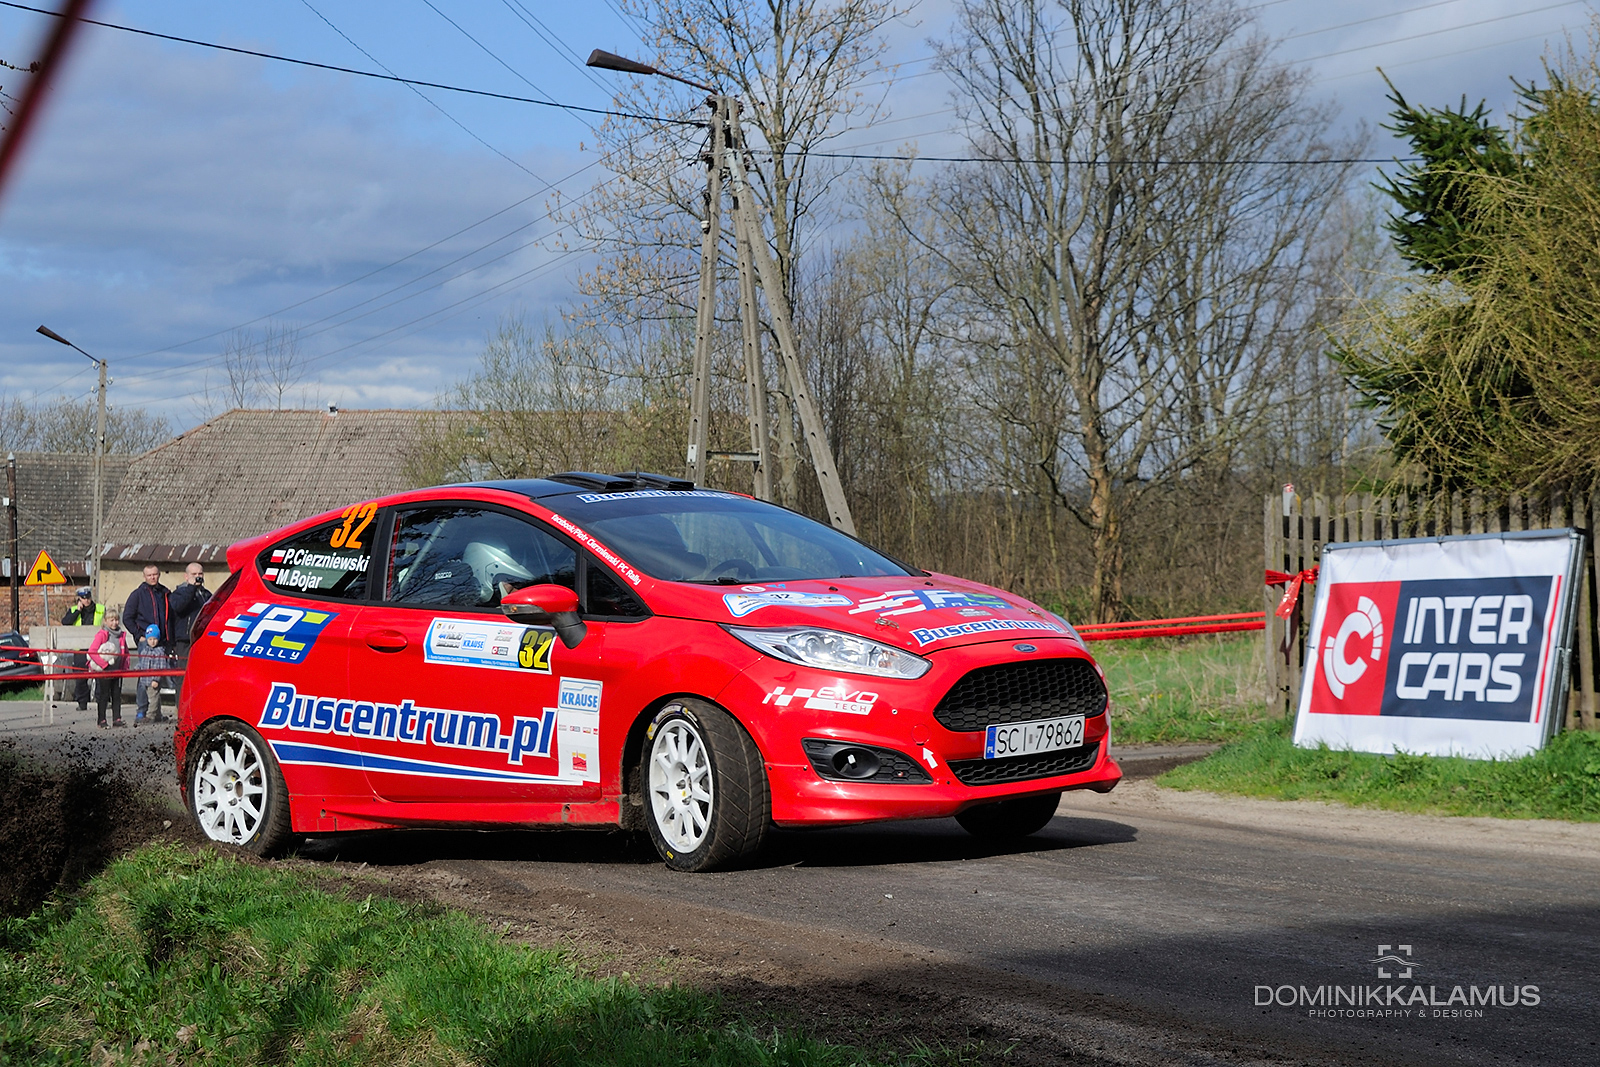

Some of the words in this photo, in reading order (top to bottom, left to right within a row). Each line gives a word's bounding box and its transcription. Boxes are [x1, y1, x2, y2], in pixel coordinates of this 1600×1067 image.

[329, 502, 378, 549] 32
[282, 548, 371, 572] P.Cierzniewski
[275, 568, 323, 592] M.Bojar
[617, 561, 628, 574] PC
[625, 568, 642, 586] Rally
[1403, 595, 1534, 644] INTER
[240, 644, 301, 661] RALLY
[462, 639, 484, 649] KRAUSE
[518, 630, 553, 669] 32
[1396, 652, 1526, 703] CARS
[561, 691, 598, 708] KRAUSE
[834, 702, 867, 713] TECH
[257, 682, 558, 766] Buscentrum.pl
[997, 728, 1027, 754] SCI
[1035, 719, 1082, 751] 79862
[986, 745, 995, 754] PL
